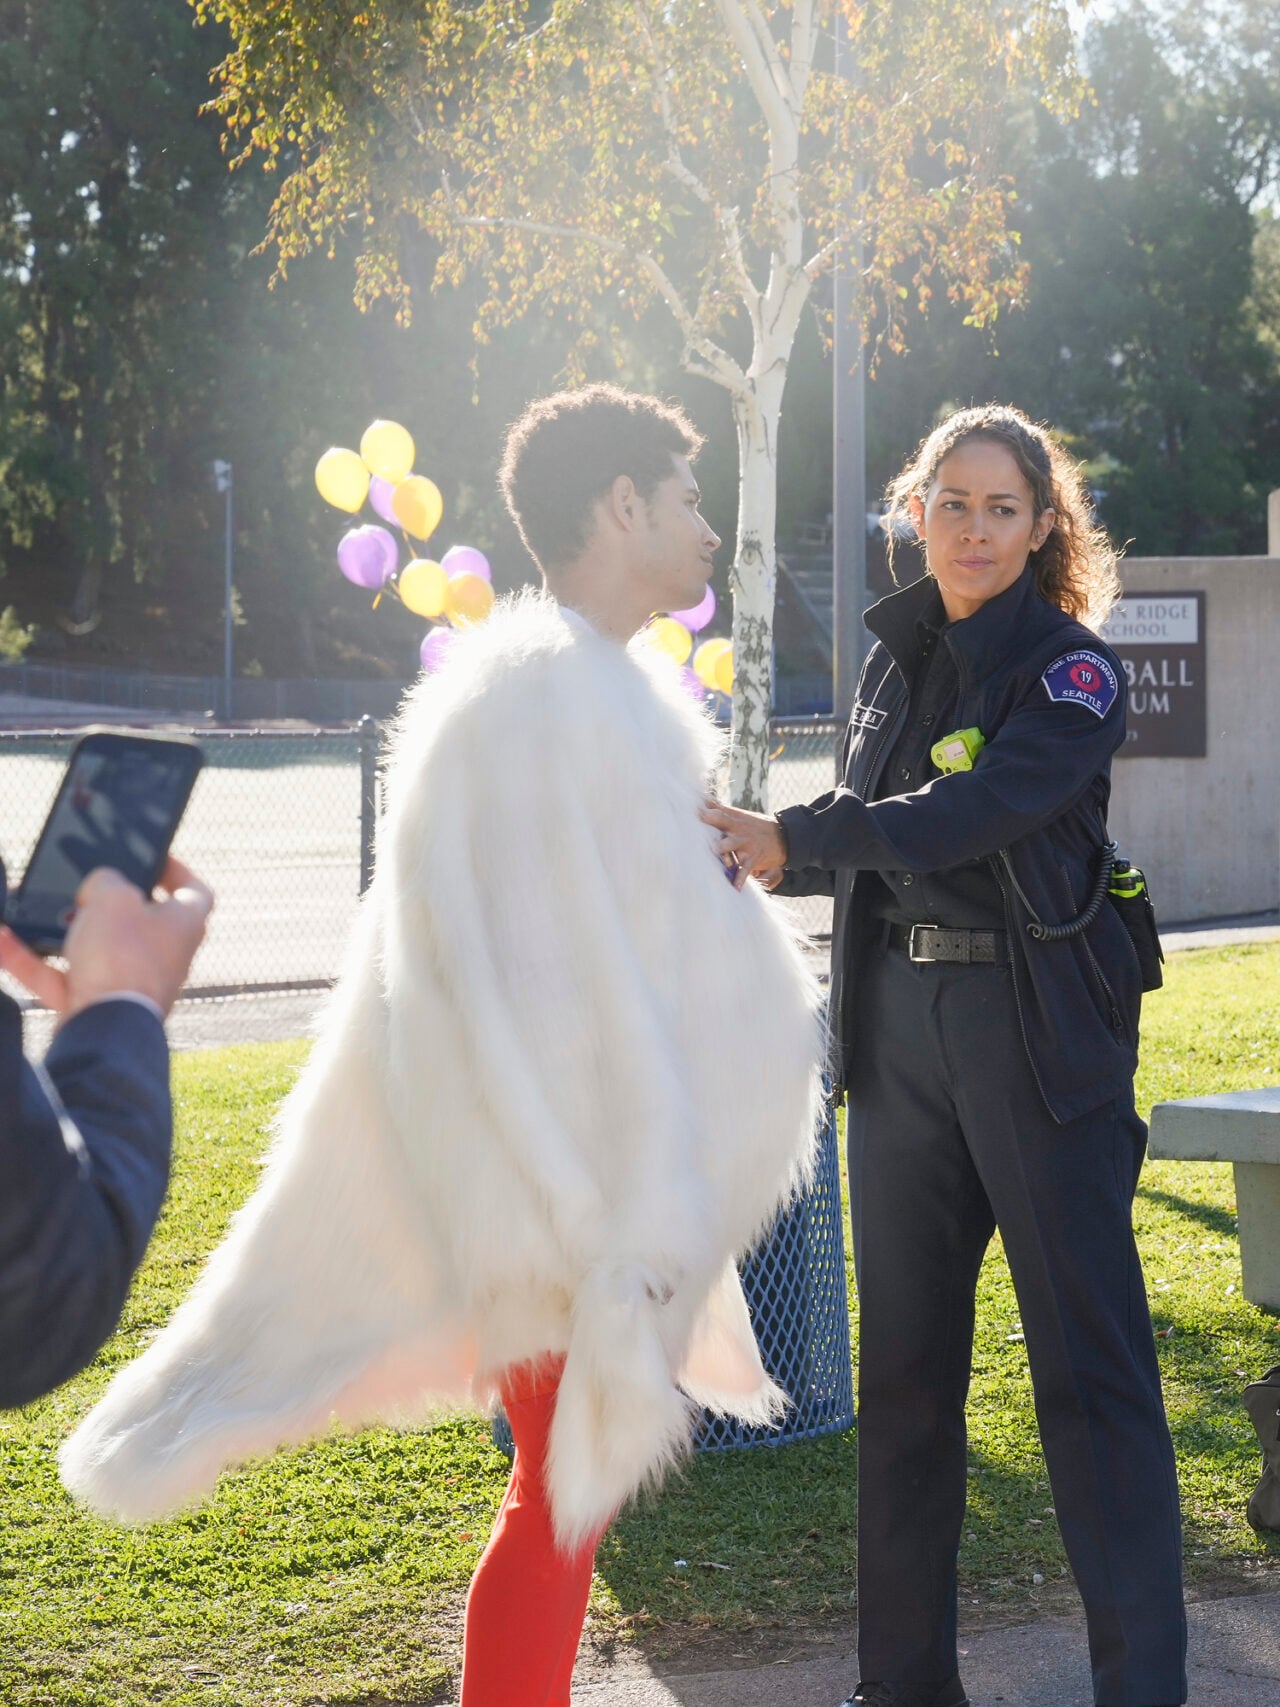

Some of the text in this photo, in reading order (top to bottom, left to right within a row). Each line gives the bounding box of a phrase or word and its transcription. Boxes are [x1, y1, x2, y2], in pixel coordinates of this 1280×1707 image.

[1136, 604, 1189, 619] RIDGE
[1047, 653, 1116, 690] FIRE DEPARTMENT
[1081, 670, 1092, 684] 19
[1062, 689, 1102, 710] SEATTLE
